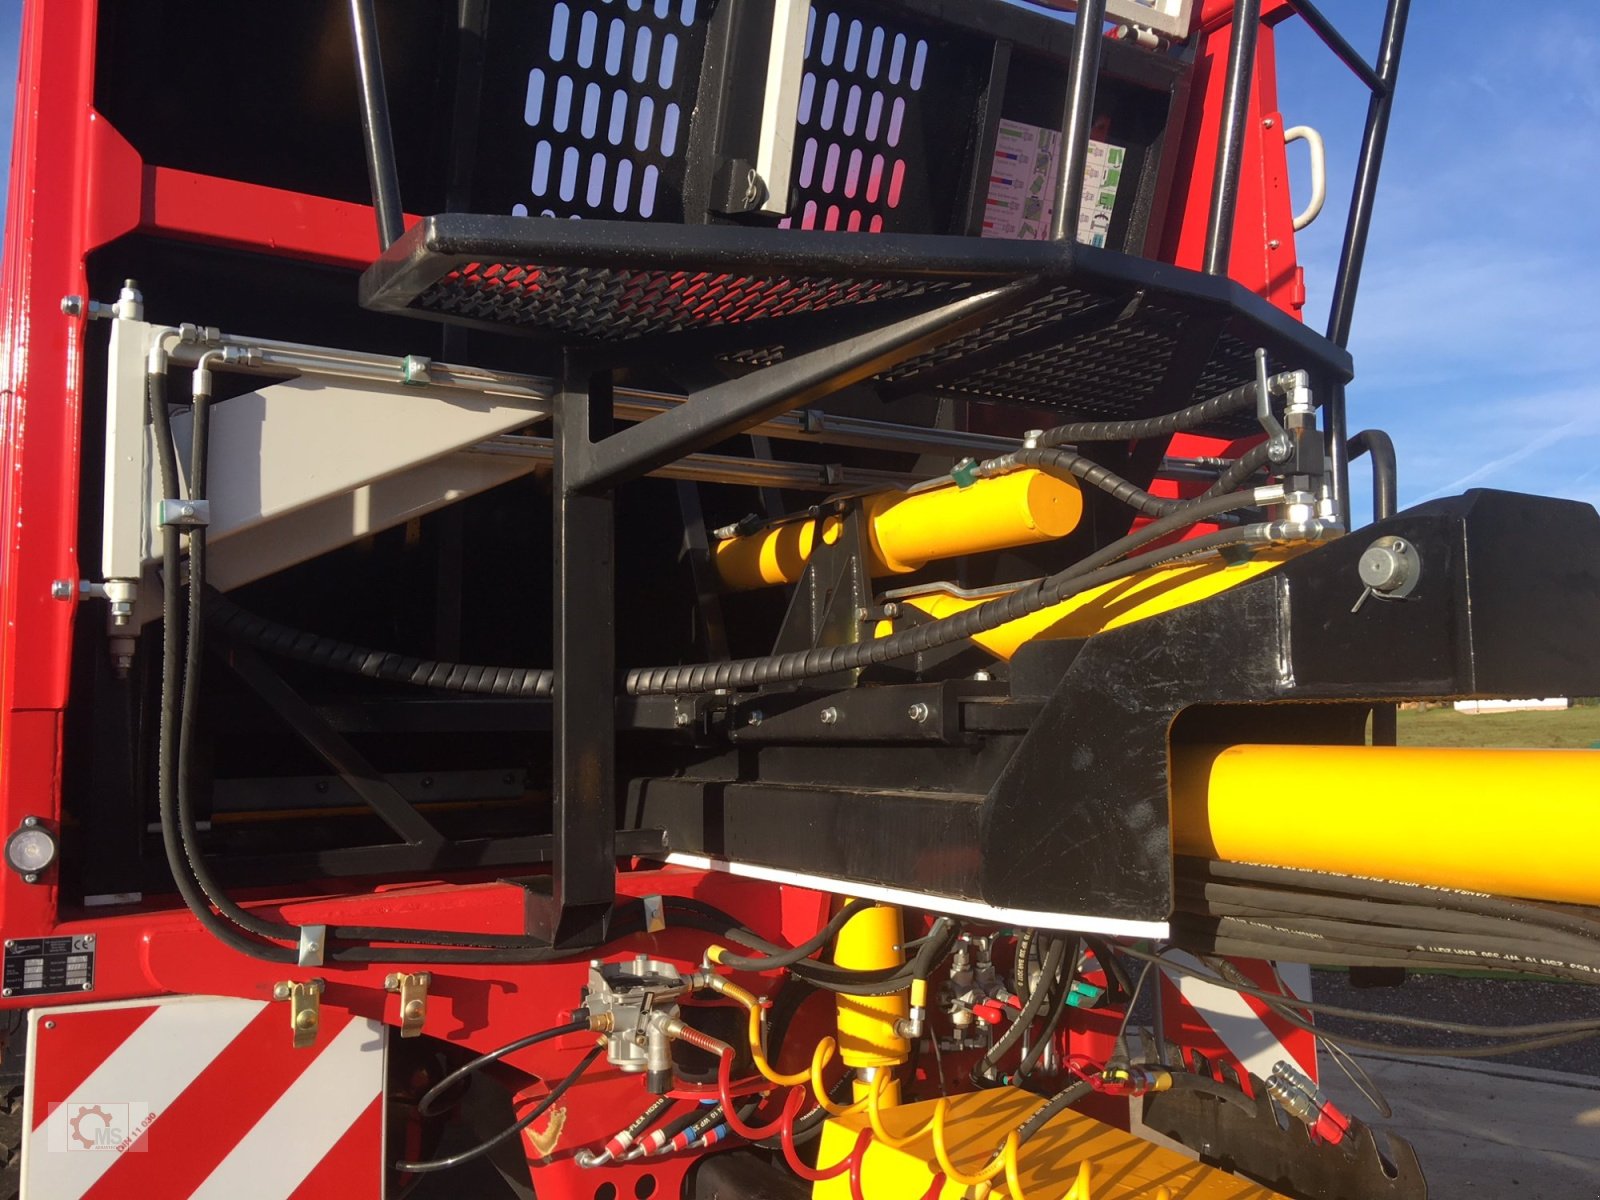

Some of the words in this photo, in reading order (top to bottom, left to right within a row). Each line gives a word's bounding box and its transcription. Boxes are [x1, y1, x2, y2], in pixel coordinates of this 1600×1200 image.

[74, 940, 89, 950] CE
[645, 1097, 665, 1116] HD210
[700, 1117, 711, 1128] WP
[116, 1135, 132, 1153] DIN
[131, 1127, 142, 1138] 11
[141, 1111, 157, 1128] 030
